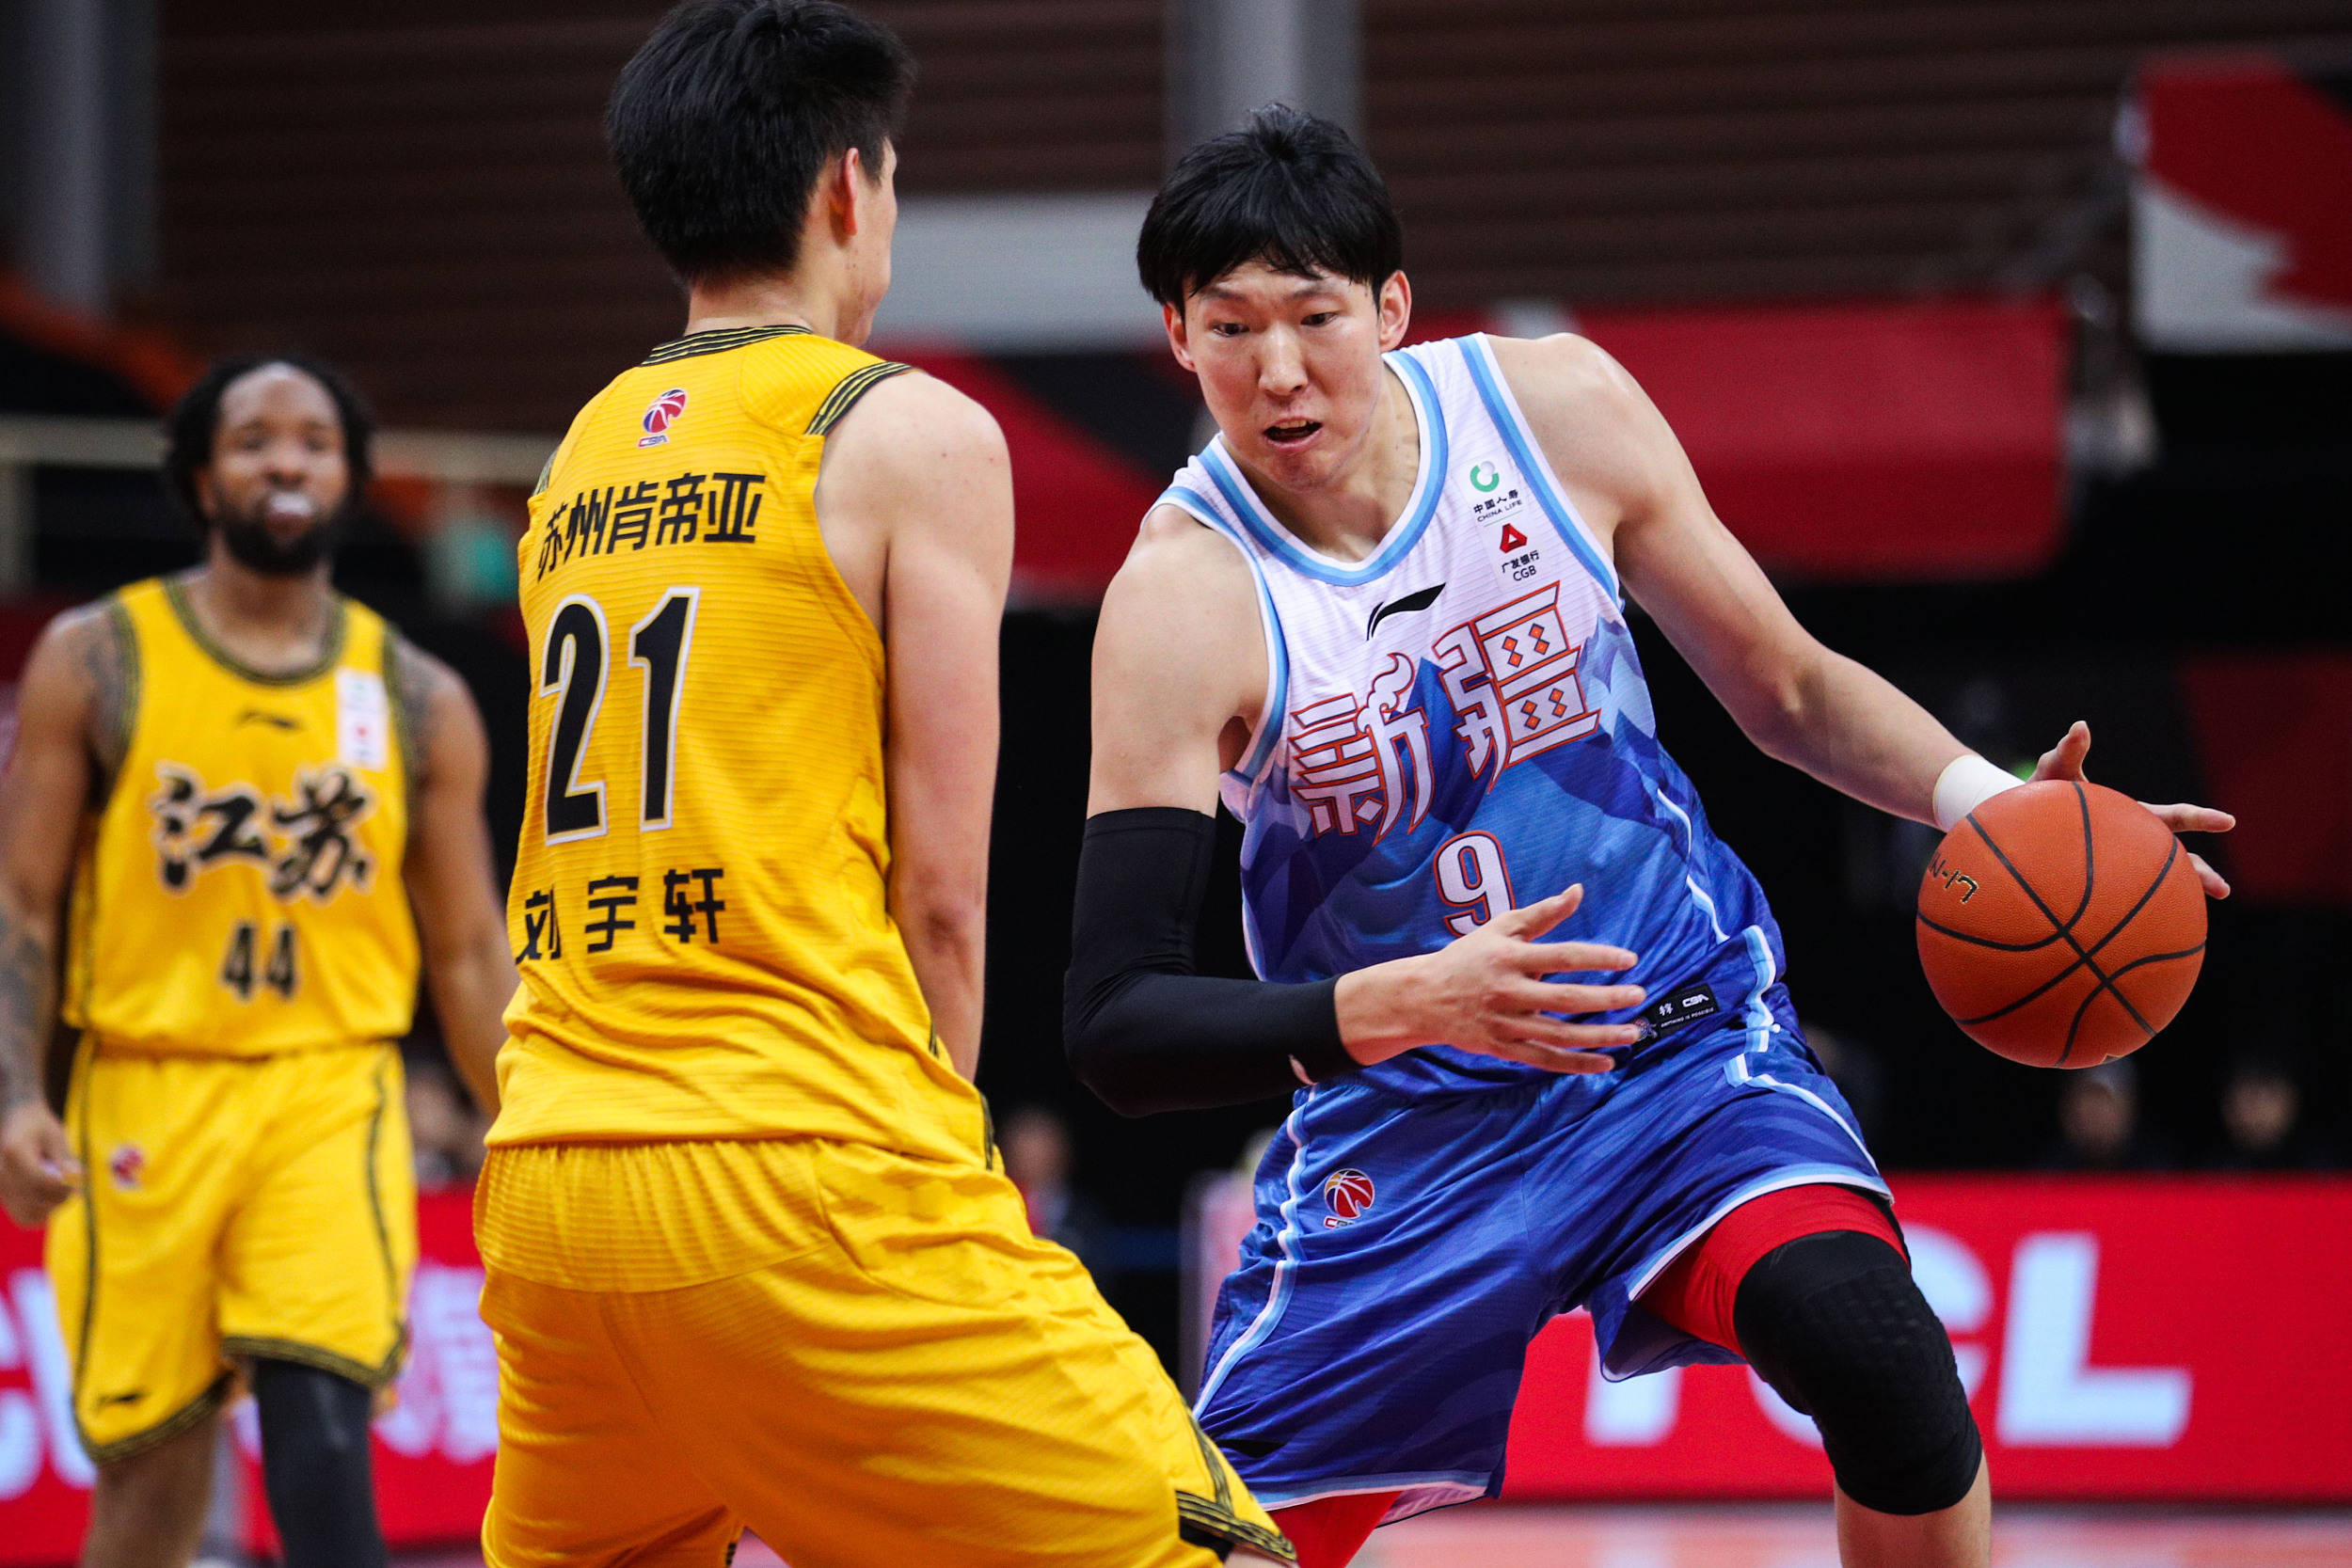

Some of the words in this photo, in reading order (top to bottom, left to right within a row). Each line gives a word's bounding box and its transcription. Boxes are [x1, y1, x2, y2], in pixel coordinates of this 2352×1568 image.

[537, 472, 766, 582] 苏州肯帝亚
[1477, 508, 1502, 522] CHINA
[1504, 499, 1522, 511] LIFE
[1501, 549, 1540, 573] 广发银行
[1513, 565, 1536, 581] CGB
[539, 586, 701, 847] 21
[1288, 579, 1602, 847] 新疆
[152, 760, 372, 905] 江苏
[515, 868, 725, 965] 刘宇轩
[1433, 830, 1516, 939] 9
[218, 920, 298, 1001] 44
